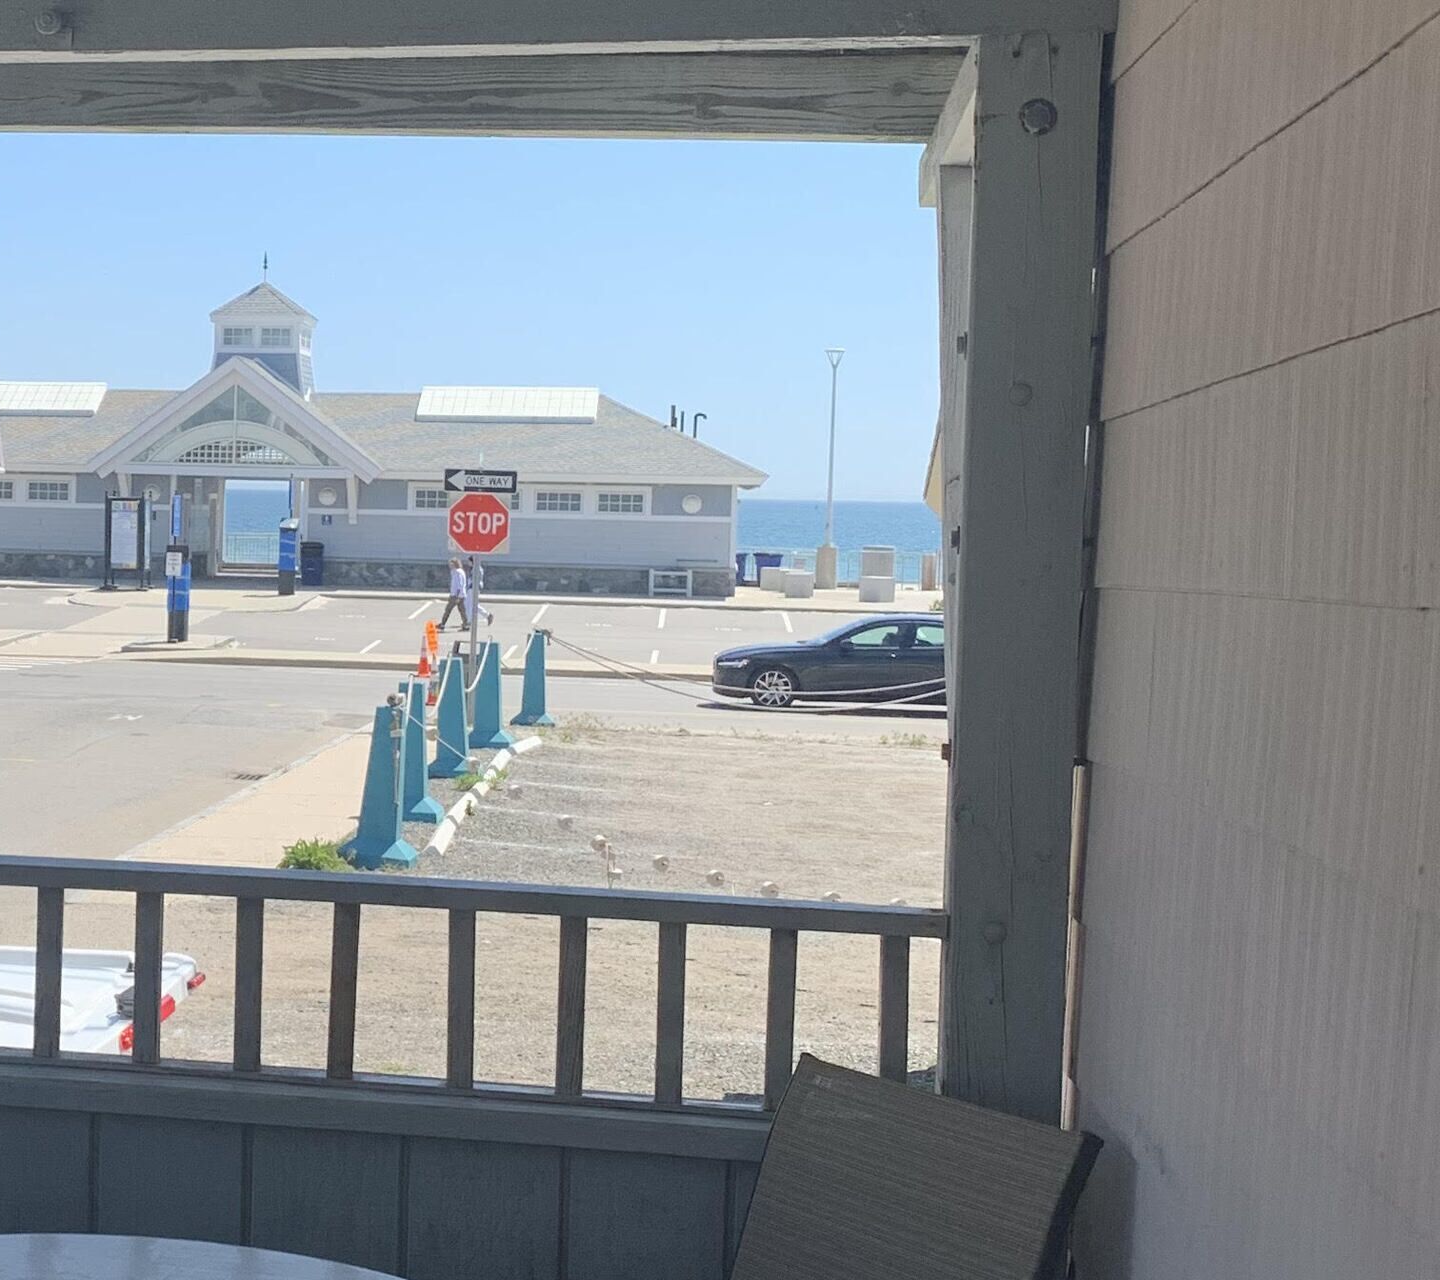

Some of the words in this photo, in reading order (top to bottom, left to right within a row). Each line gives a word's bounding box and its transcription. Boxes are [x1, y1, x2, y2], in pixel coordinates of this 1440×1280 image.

[465, 476, 485, 486] ONE
[489, 477, 510, 487] WAY
[452, 511, 506, 535] STOP
